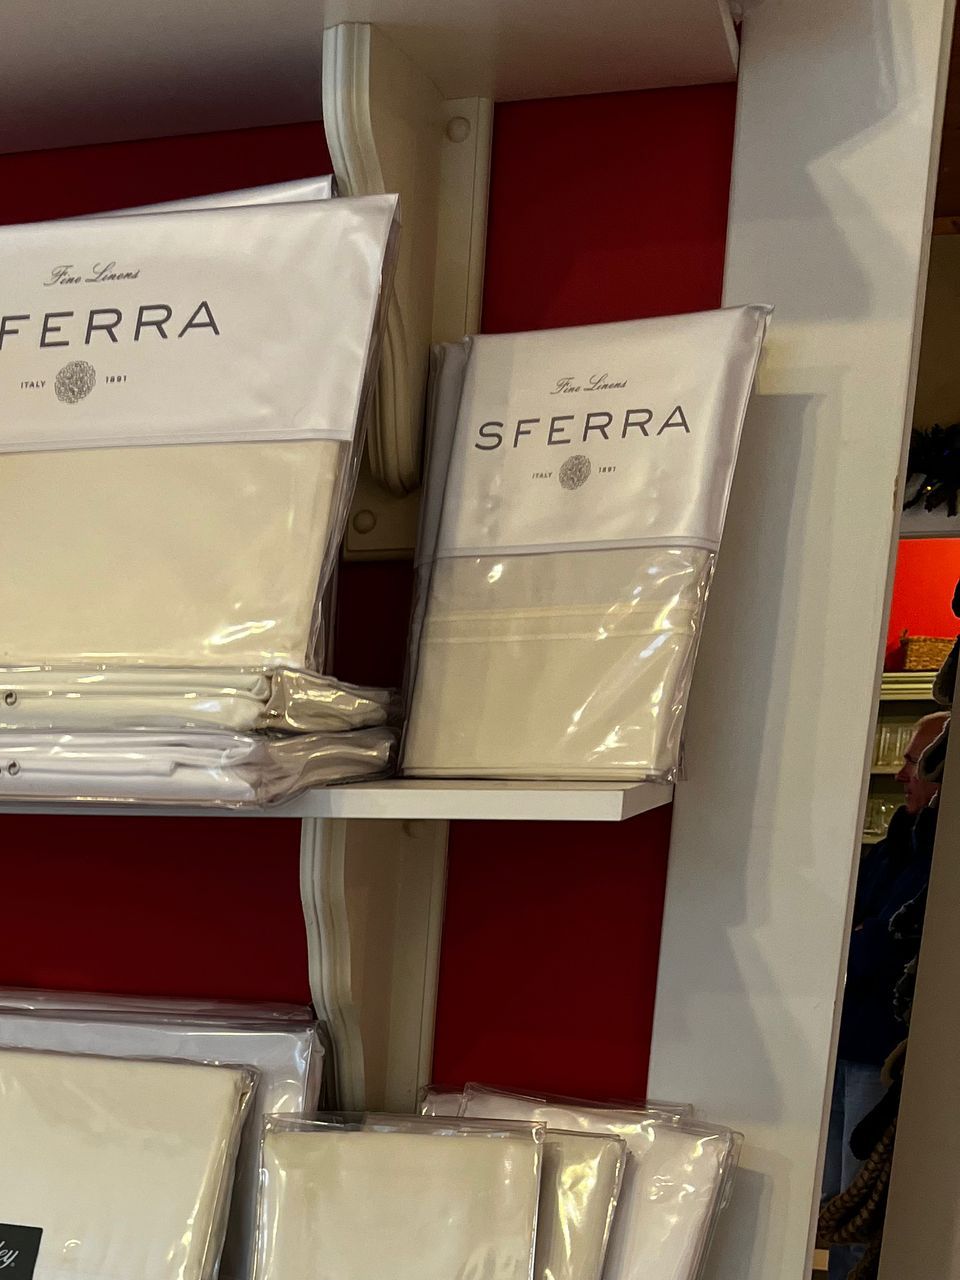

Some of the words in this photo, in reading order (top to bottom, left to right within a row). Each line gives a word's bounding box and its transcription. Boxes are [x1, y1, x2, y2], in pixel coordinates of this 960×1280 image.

[43, 265, 82, 287] Fine
[85, 261, 140, 283] Linens
[20, 380, 47, 389] ITALY
[105, 375, 128, 384] 1891
[550, 376, 580, 395] Fine
[583, 373, 628, 392] Linens
[475, 405, 691, 450] SFERRA
